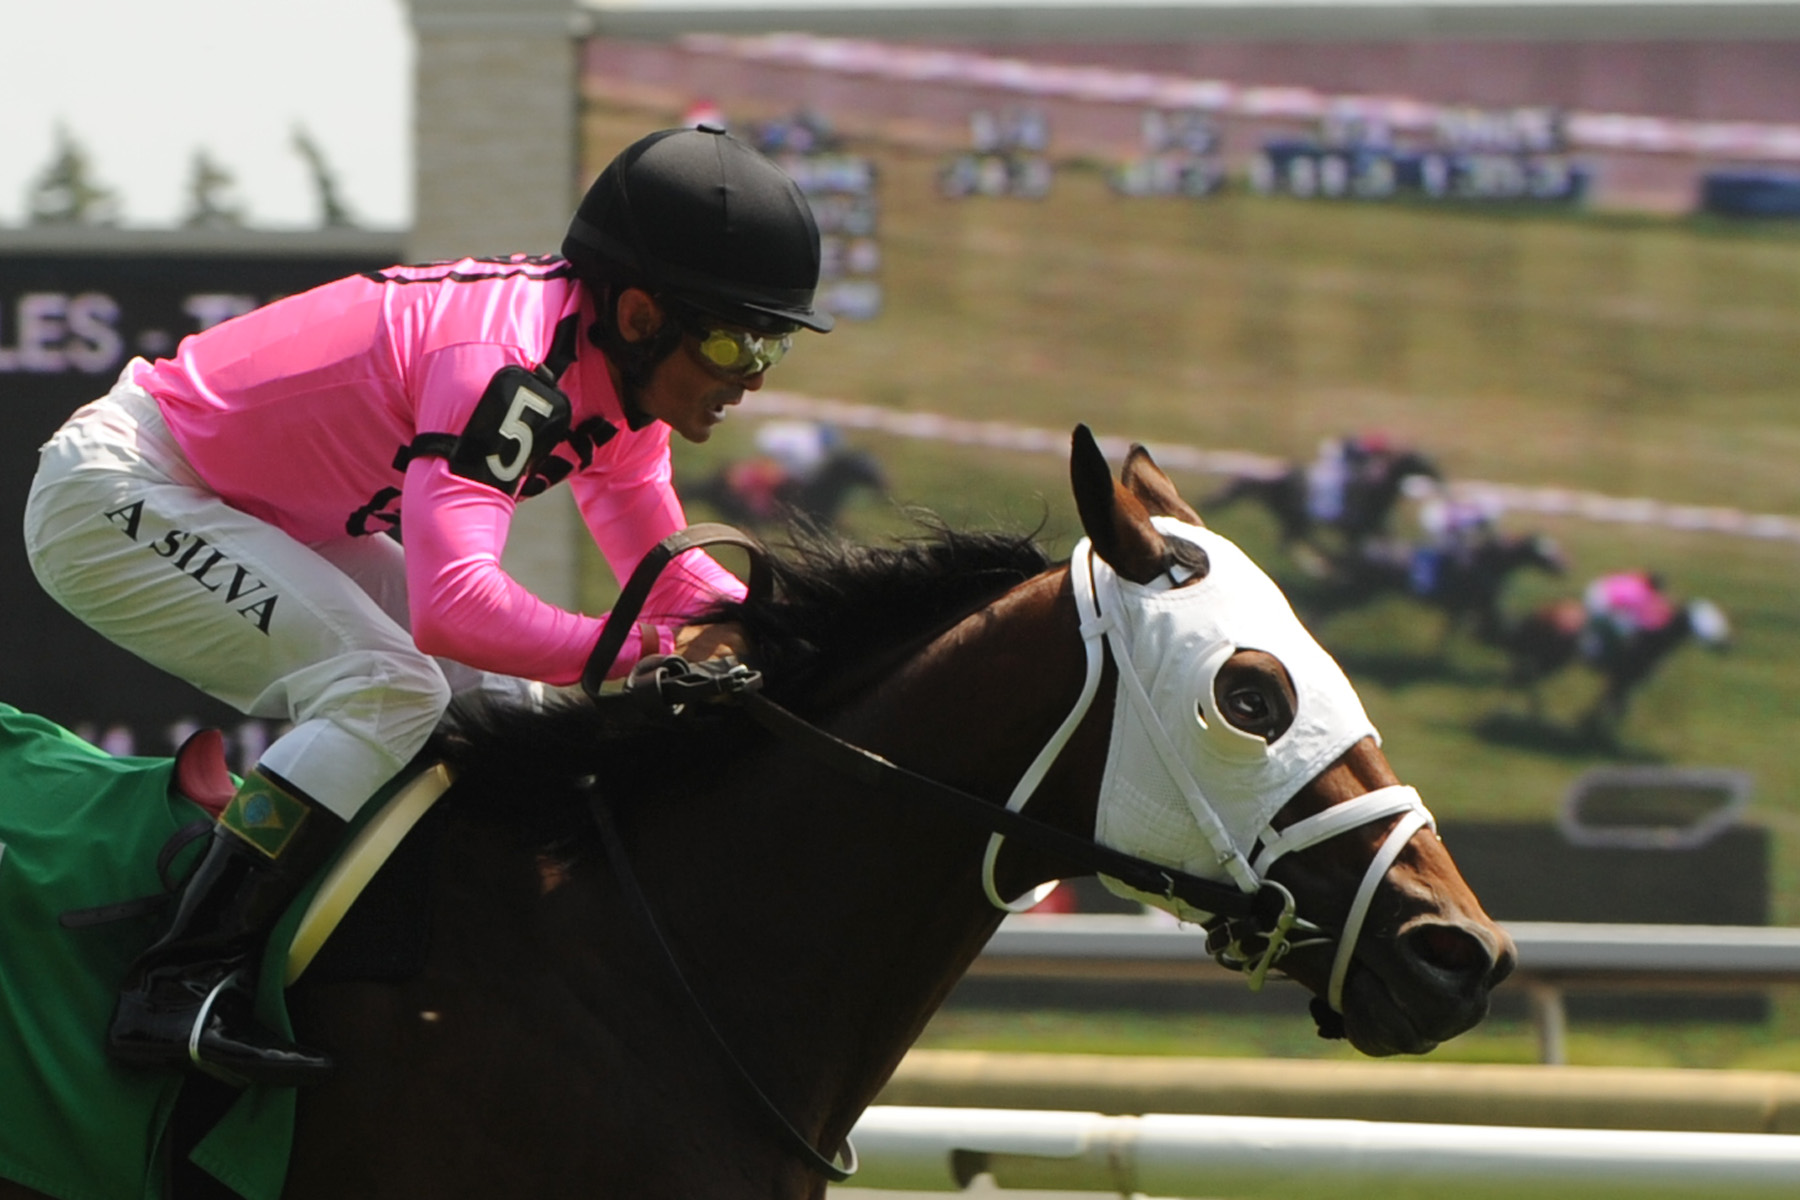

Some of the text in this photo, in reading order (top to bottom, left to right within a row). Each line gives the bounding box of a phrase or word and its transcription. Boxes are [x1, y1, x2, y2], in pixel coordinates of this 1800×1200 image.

[485, 384, 555, 482] 5
[103, 498, 280, 637] A SILVA
